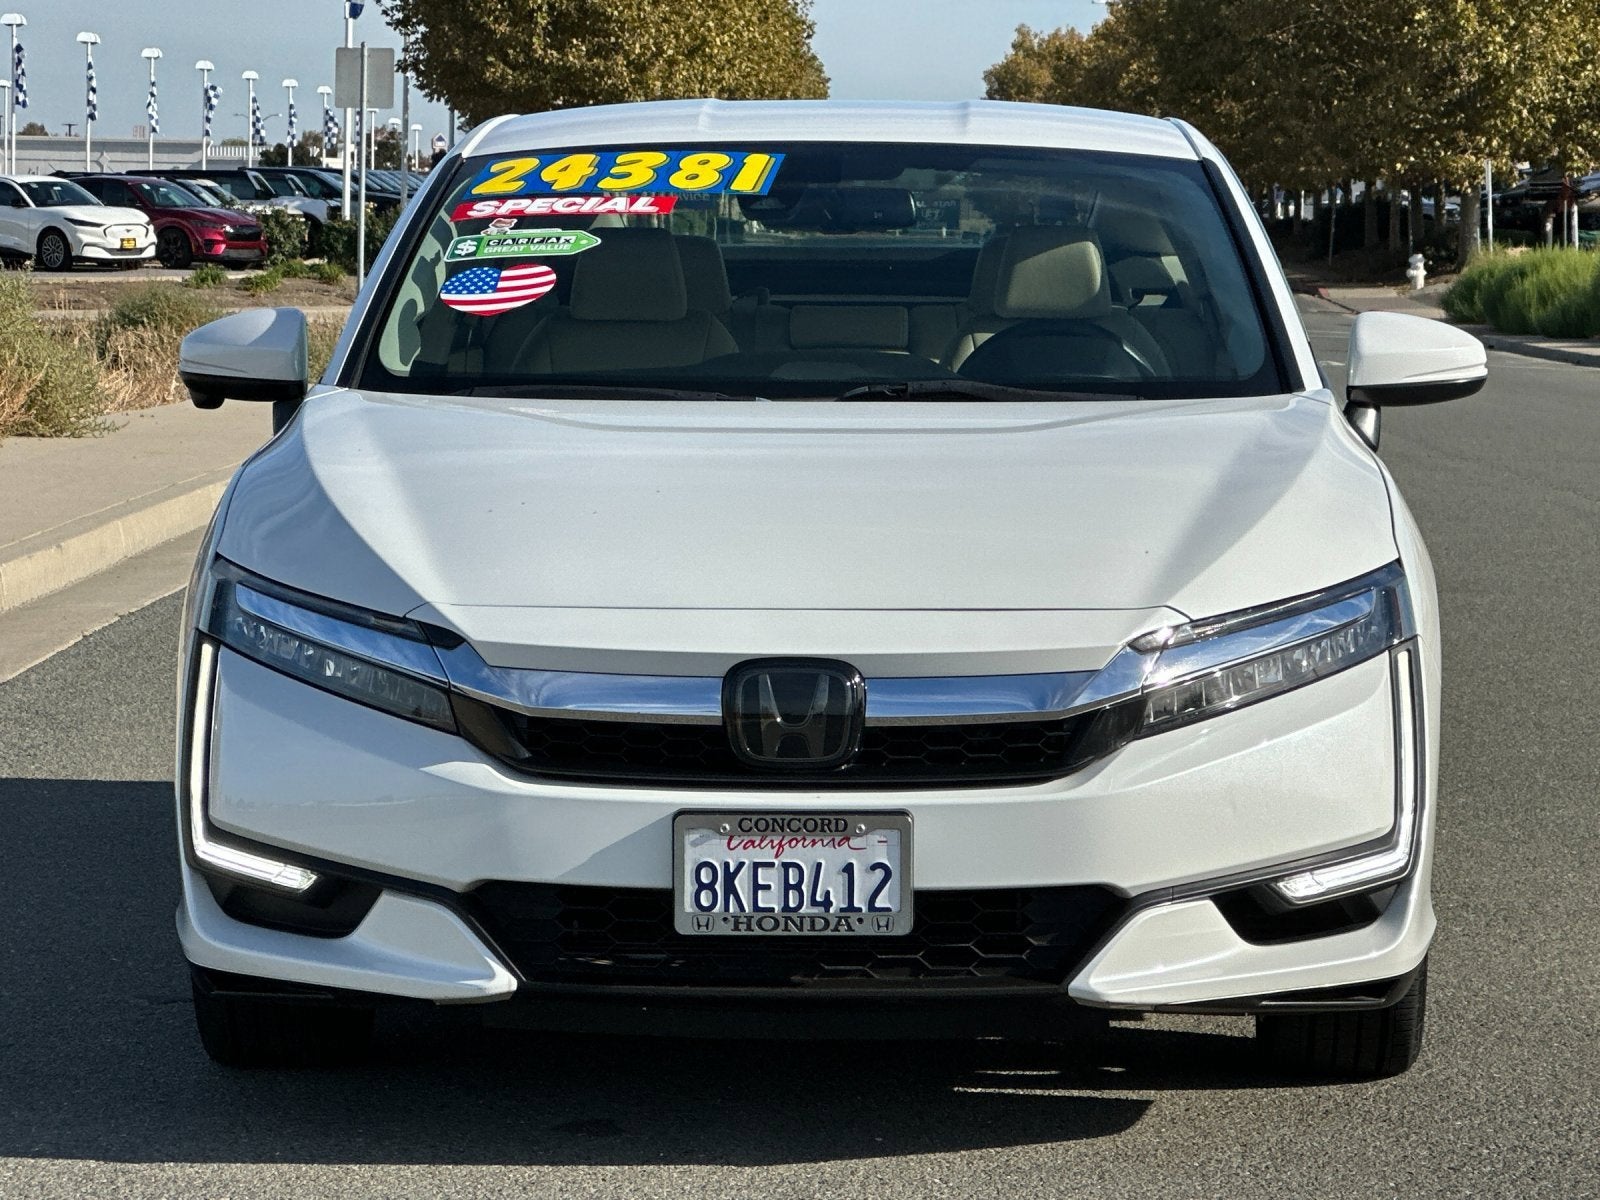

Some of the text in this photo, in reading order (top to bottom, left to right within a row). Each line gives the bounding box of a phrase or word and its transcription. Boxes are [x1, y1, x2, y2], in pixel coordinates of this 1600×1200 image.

[471, 152, 775, 195] 24381
[466, 196, 661, 217] SPECIAL
[483, 243, 572, 254] GREAT VALUE
[488, 235, 576, 247] CARFAX
[737, 817, 849, 834] CONCORD
[726, 834, 867, 860] California
[693, 860, 893, 913] 8KEB412
[730, 915, 855, 932] HONDA
